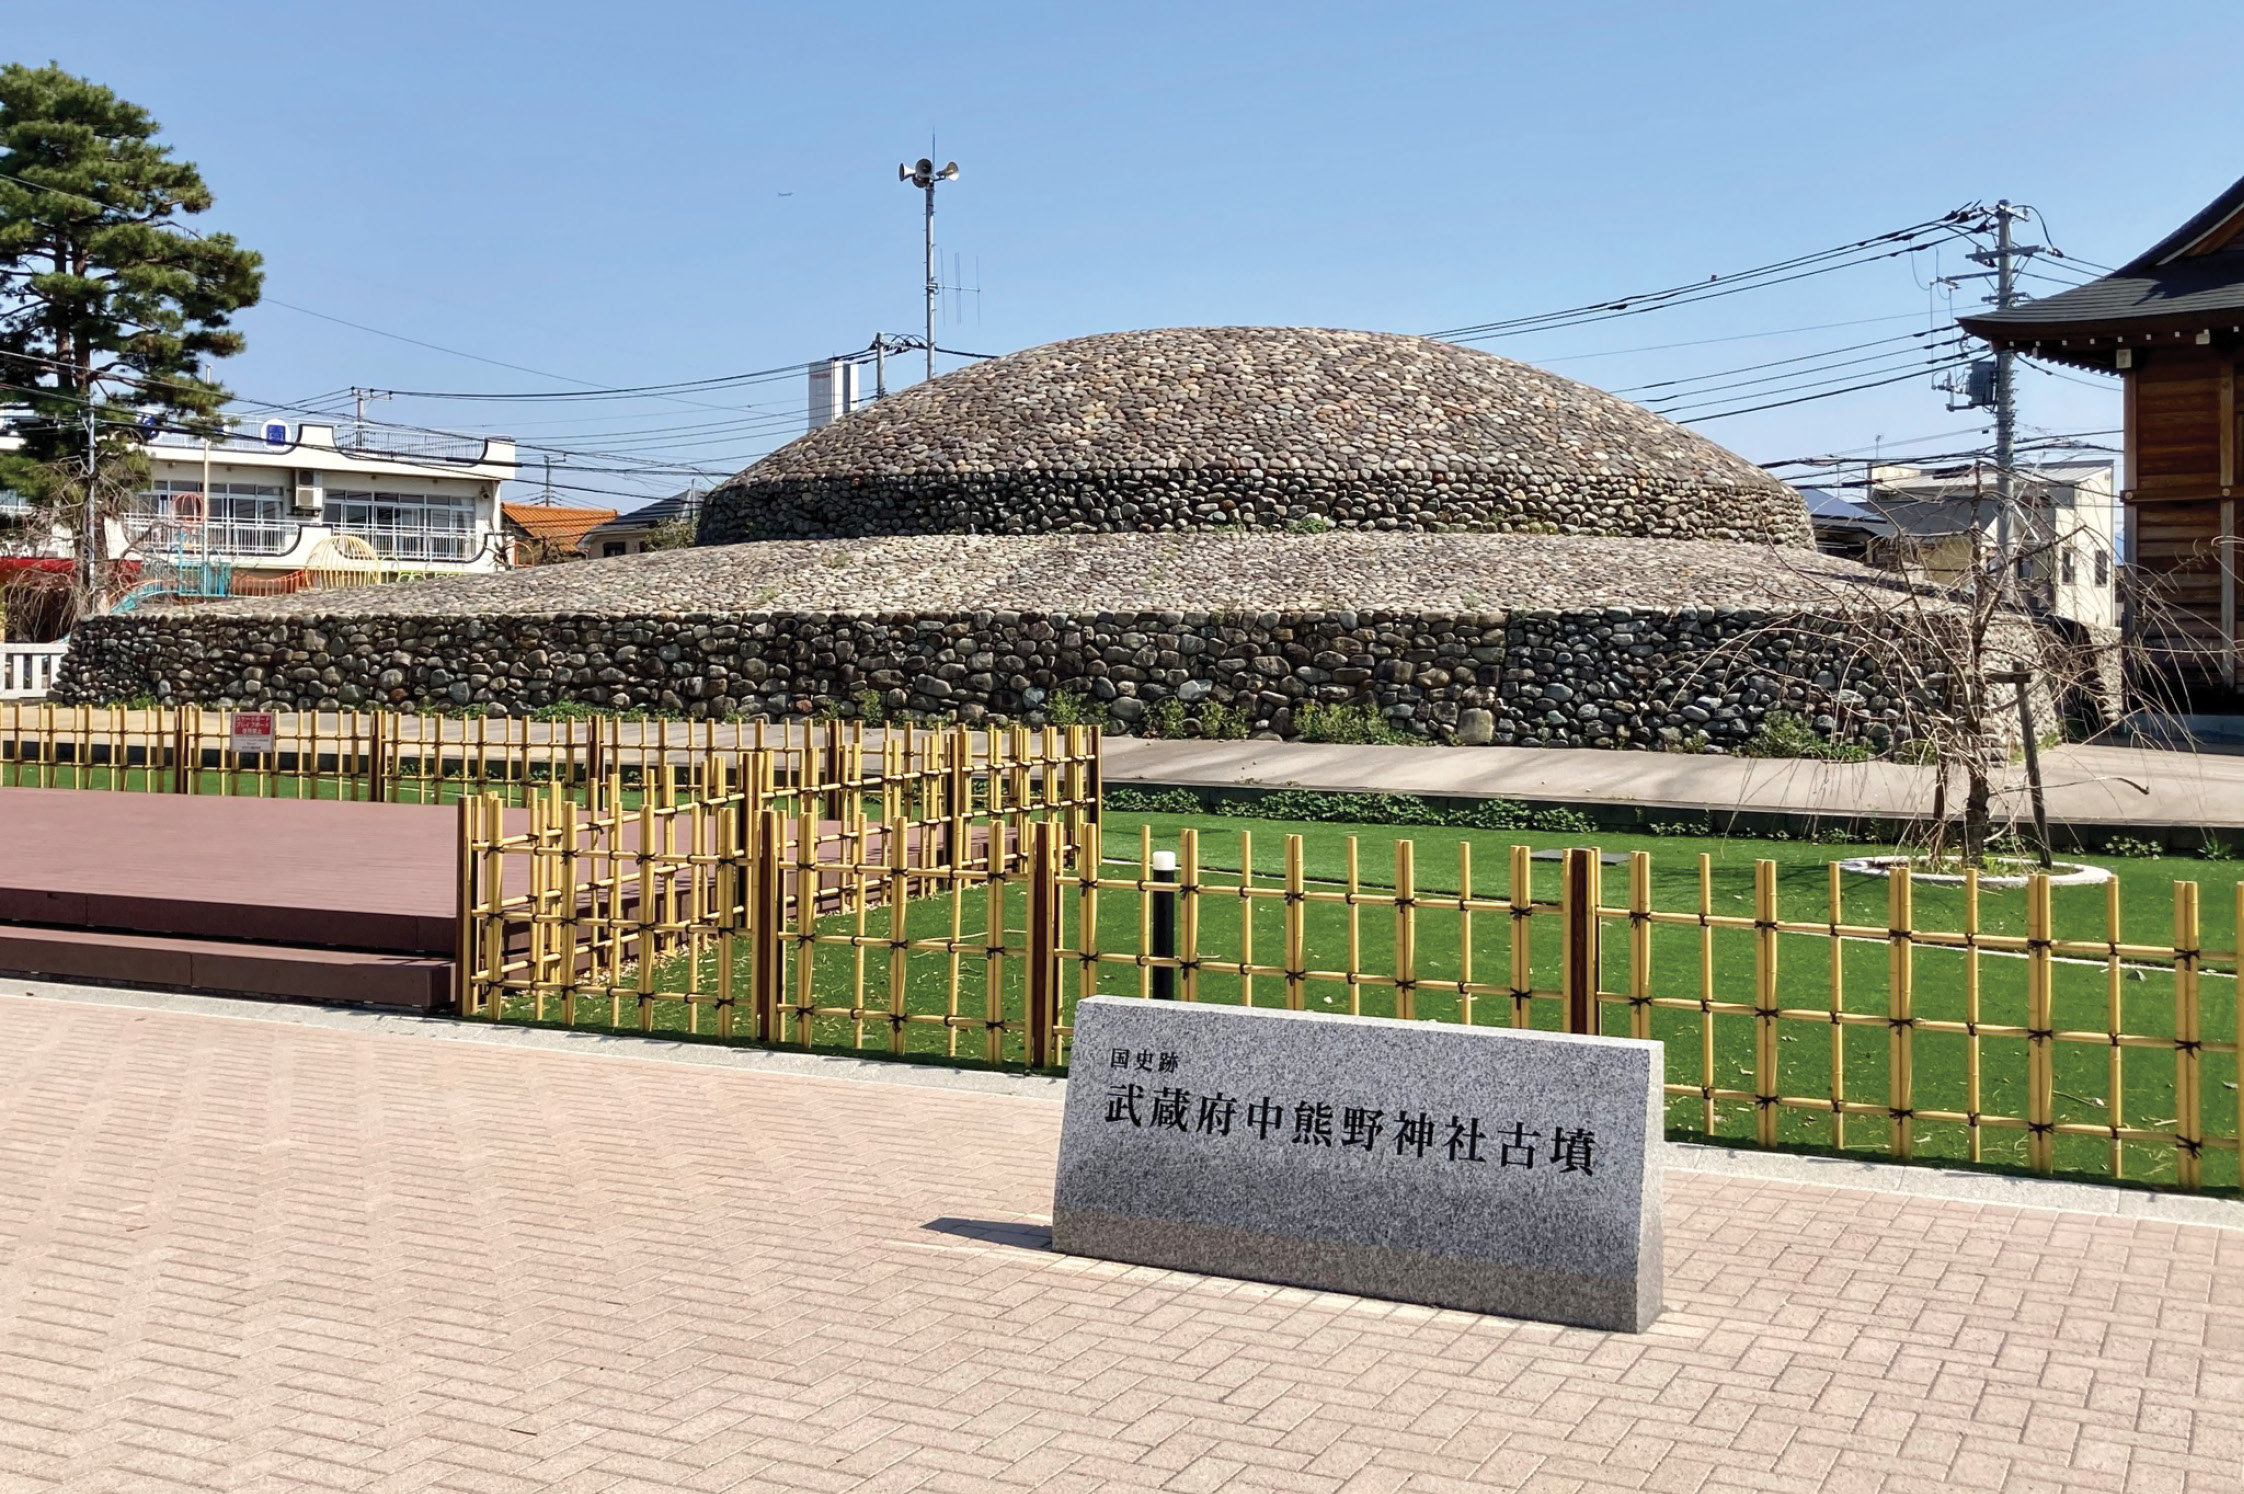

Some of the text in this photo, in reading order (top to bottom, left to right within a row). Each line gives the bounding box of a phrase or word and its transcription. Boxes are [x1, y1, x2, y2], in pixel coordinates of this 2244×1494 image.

[1110, 1048, 1179, 1073] 国史跡
[1105, 1083, 1597, 1177] 武蔵府中熊野神社古墳
